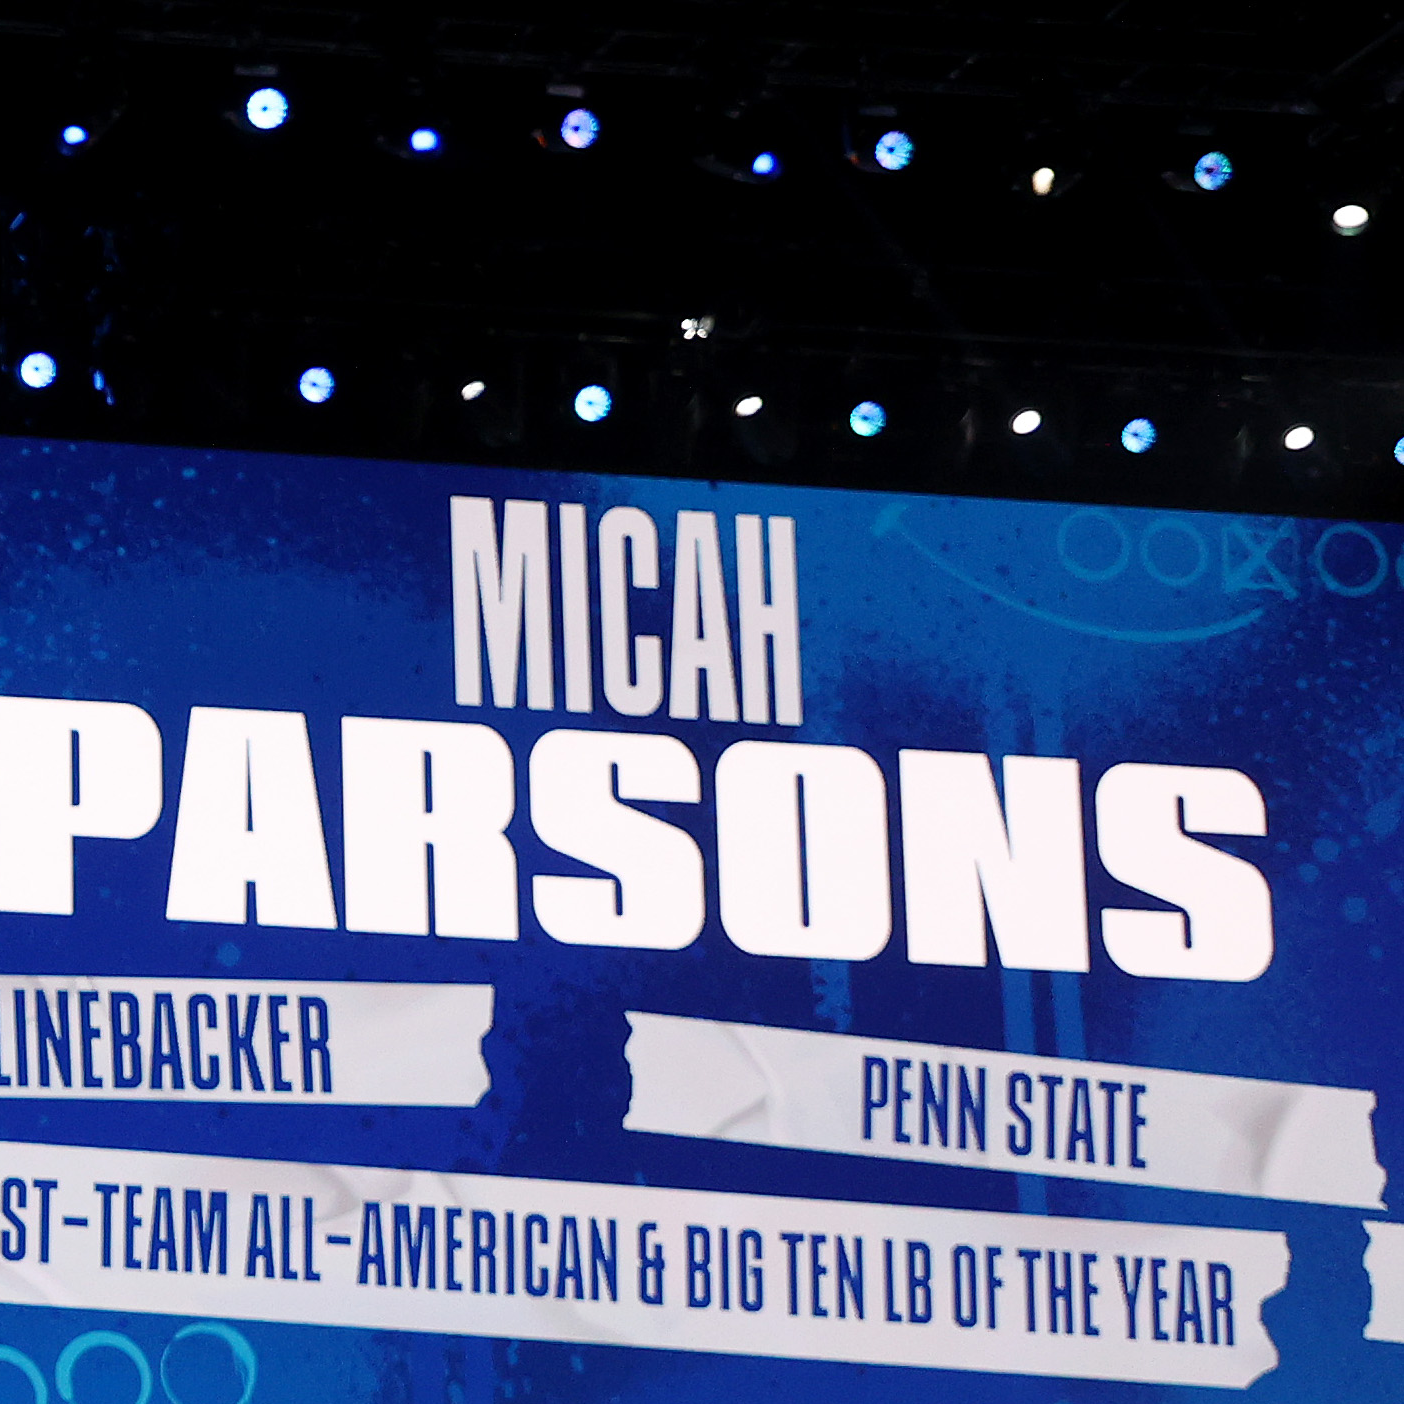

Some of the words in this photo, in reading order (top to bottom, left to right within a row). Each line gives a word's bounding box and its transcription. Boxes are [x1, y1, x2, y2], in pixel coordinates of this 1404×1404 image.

[449, 495, 803, 726] MICAH
[864, 1056, 986, 1152] PENN
[1009, 1072, 1146, 1168] STATE
[247, 1194, 617, 1302] ALL-AMERICAN
[639, 1223, 665, 1305] &
[687, 1225, 763, 1312] BIG
[781, 1233, 864, 1319] TEN
[885, 1239, 932, 1324] LB
[953, 1246, 1002, 1329] OF
[1018, 1248, 1100, 1337] THE
[1118, 1256, 1234, 1346] YEAR
